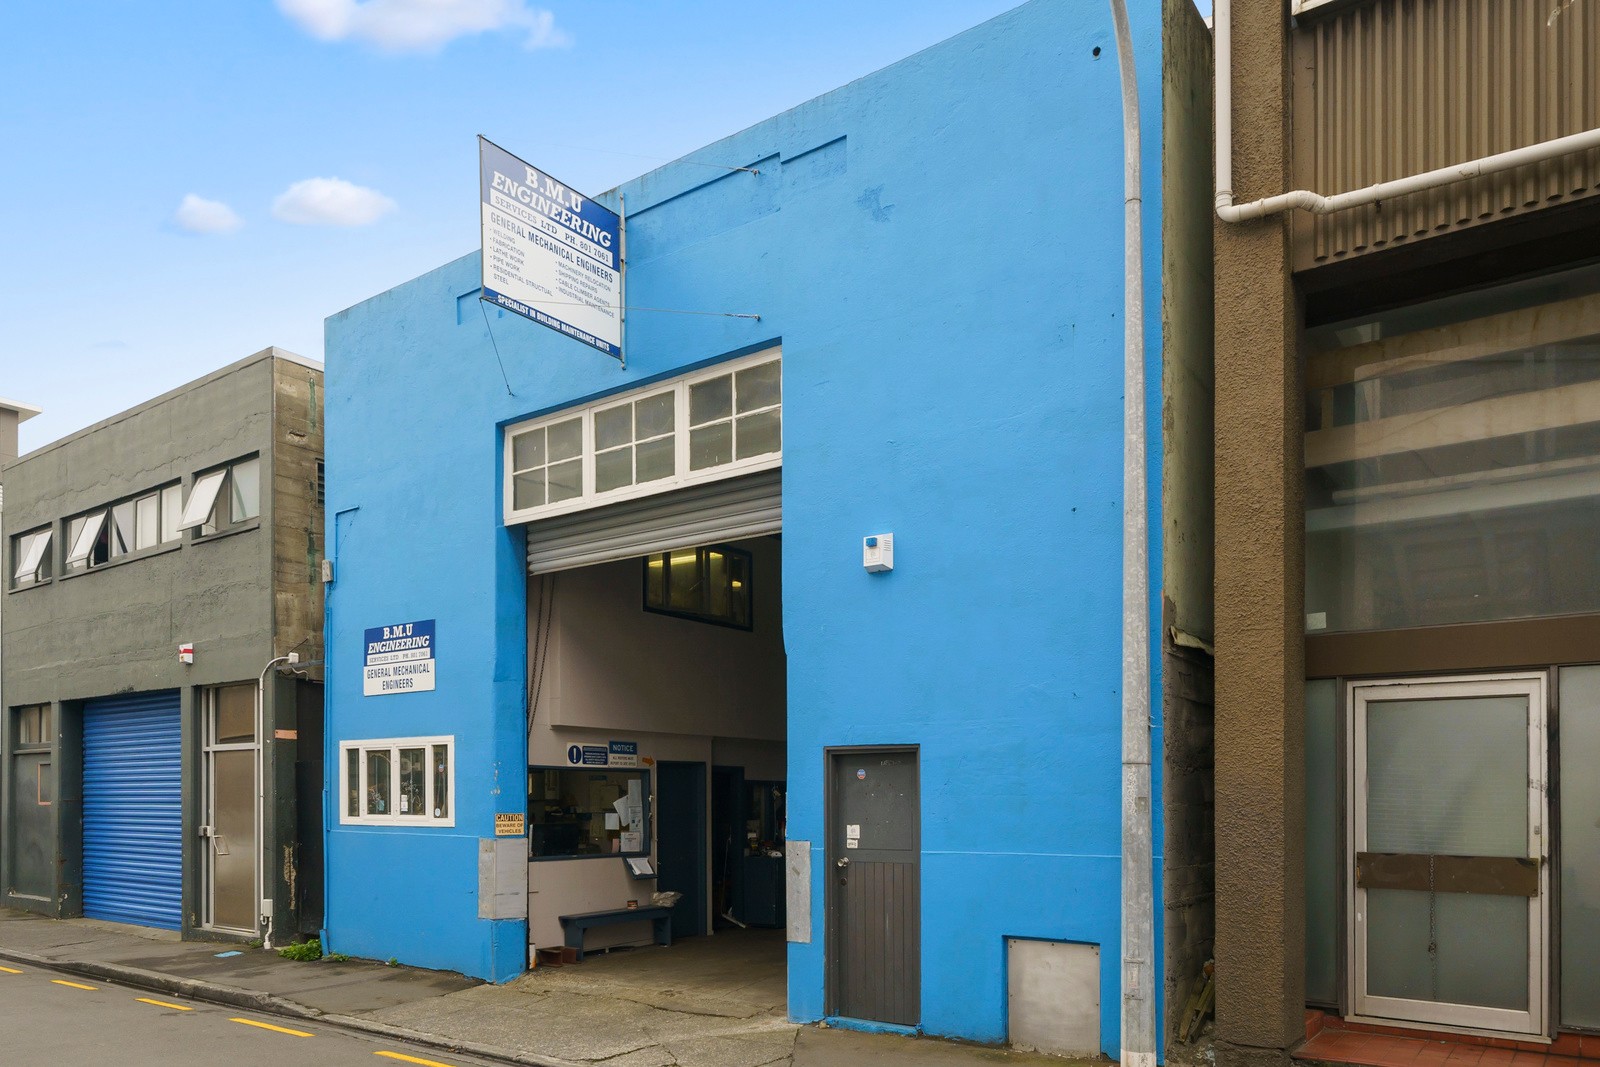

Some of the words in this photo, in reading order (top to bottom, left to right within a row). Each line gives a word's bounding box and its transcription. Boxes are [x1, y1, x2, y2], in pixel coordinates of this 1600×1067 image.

[525, 166, 582, 213] B.M.U
[491, 171, 612, 248] ENGINEERING
[493, 228, 516, 244] WELDING
[495, 195, 537, 224] SERVICES
[540, 219, 558, 235] LTD
[579, 240, 593, 253] 801
[593, 246, 610, 262] 7061
[490, 211, 526, 239] GENERAL
[528, 231, 575, 263] MECHANICAL
[576, 255, 614, 283] ENGINEERS
[493, 237, 525, 258] FABRICATION
[493, 246, 508, 259] LATHE
[509, 254, 525, 266] WORK
[493, 255, 504, 267] PIPE
[505, 260, 521, 272] WORK
[493, 264, 525, 283] RESIDENTIAL
[493, 273, 509, 286] STEEL
[558, 261, 584, 278] MACHINERY
[584, 274, 611, 292] RELOCATION
[559, 278, 573, 291] CABLE
[579, 279, 598, 294] REPAIRS
[559, 286, 585, 304] INDUSTRIAL
[584, 299, 615, 319] MAINTENANCE
[497, 294, 529, 315] SPECIALIST
[561, 322, 595, 345] MAINTENANCE
[383, 623, 413, 640] B.M.U
[367, 635, 430, 654] ENGINEERING
[369, 655, 389, 664] SERVICES
[367, 667, 391, 679] GENERAL
[393, 663, 430, 677] MECHANICAL
[382, 678, 414, 691] ENGINEERS
[612, 744, 634, 752] NOTICE
[496, 813, 524, 821] CAUTION
